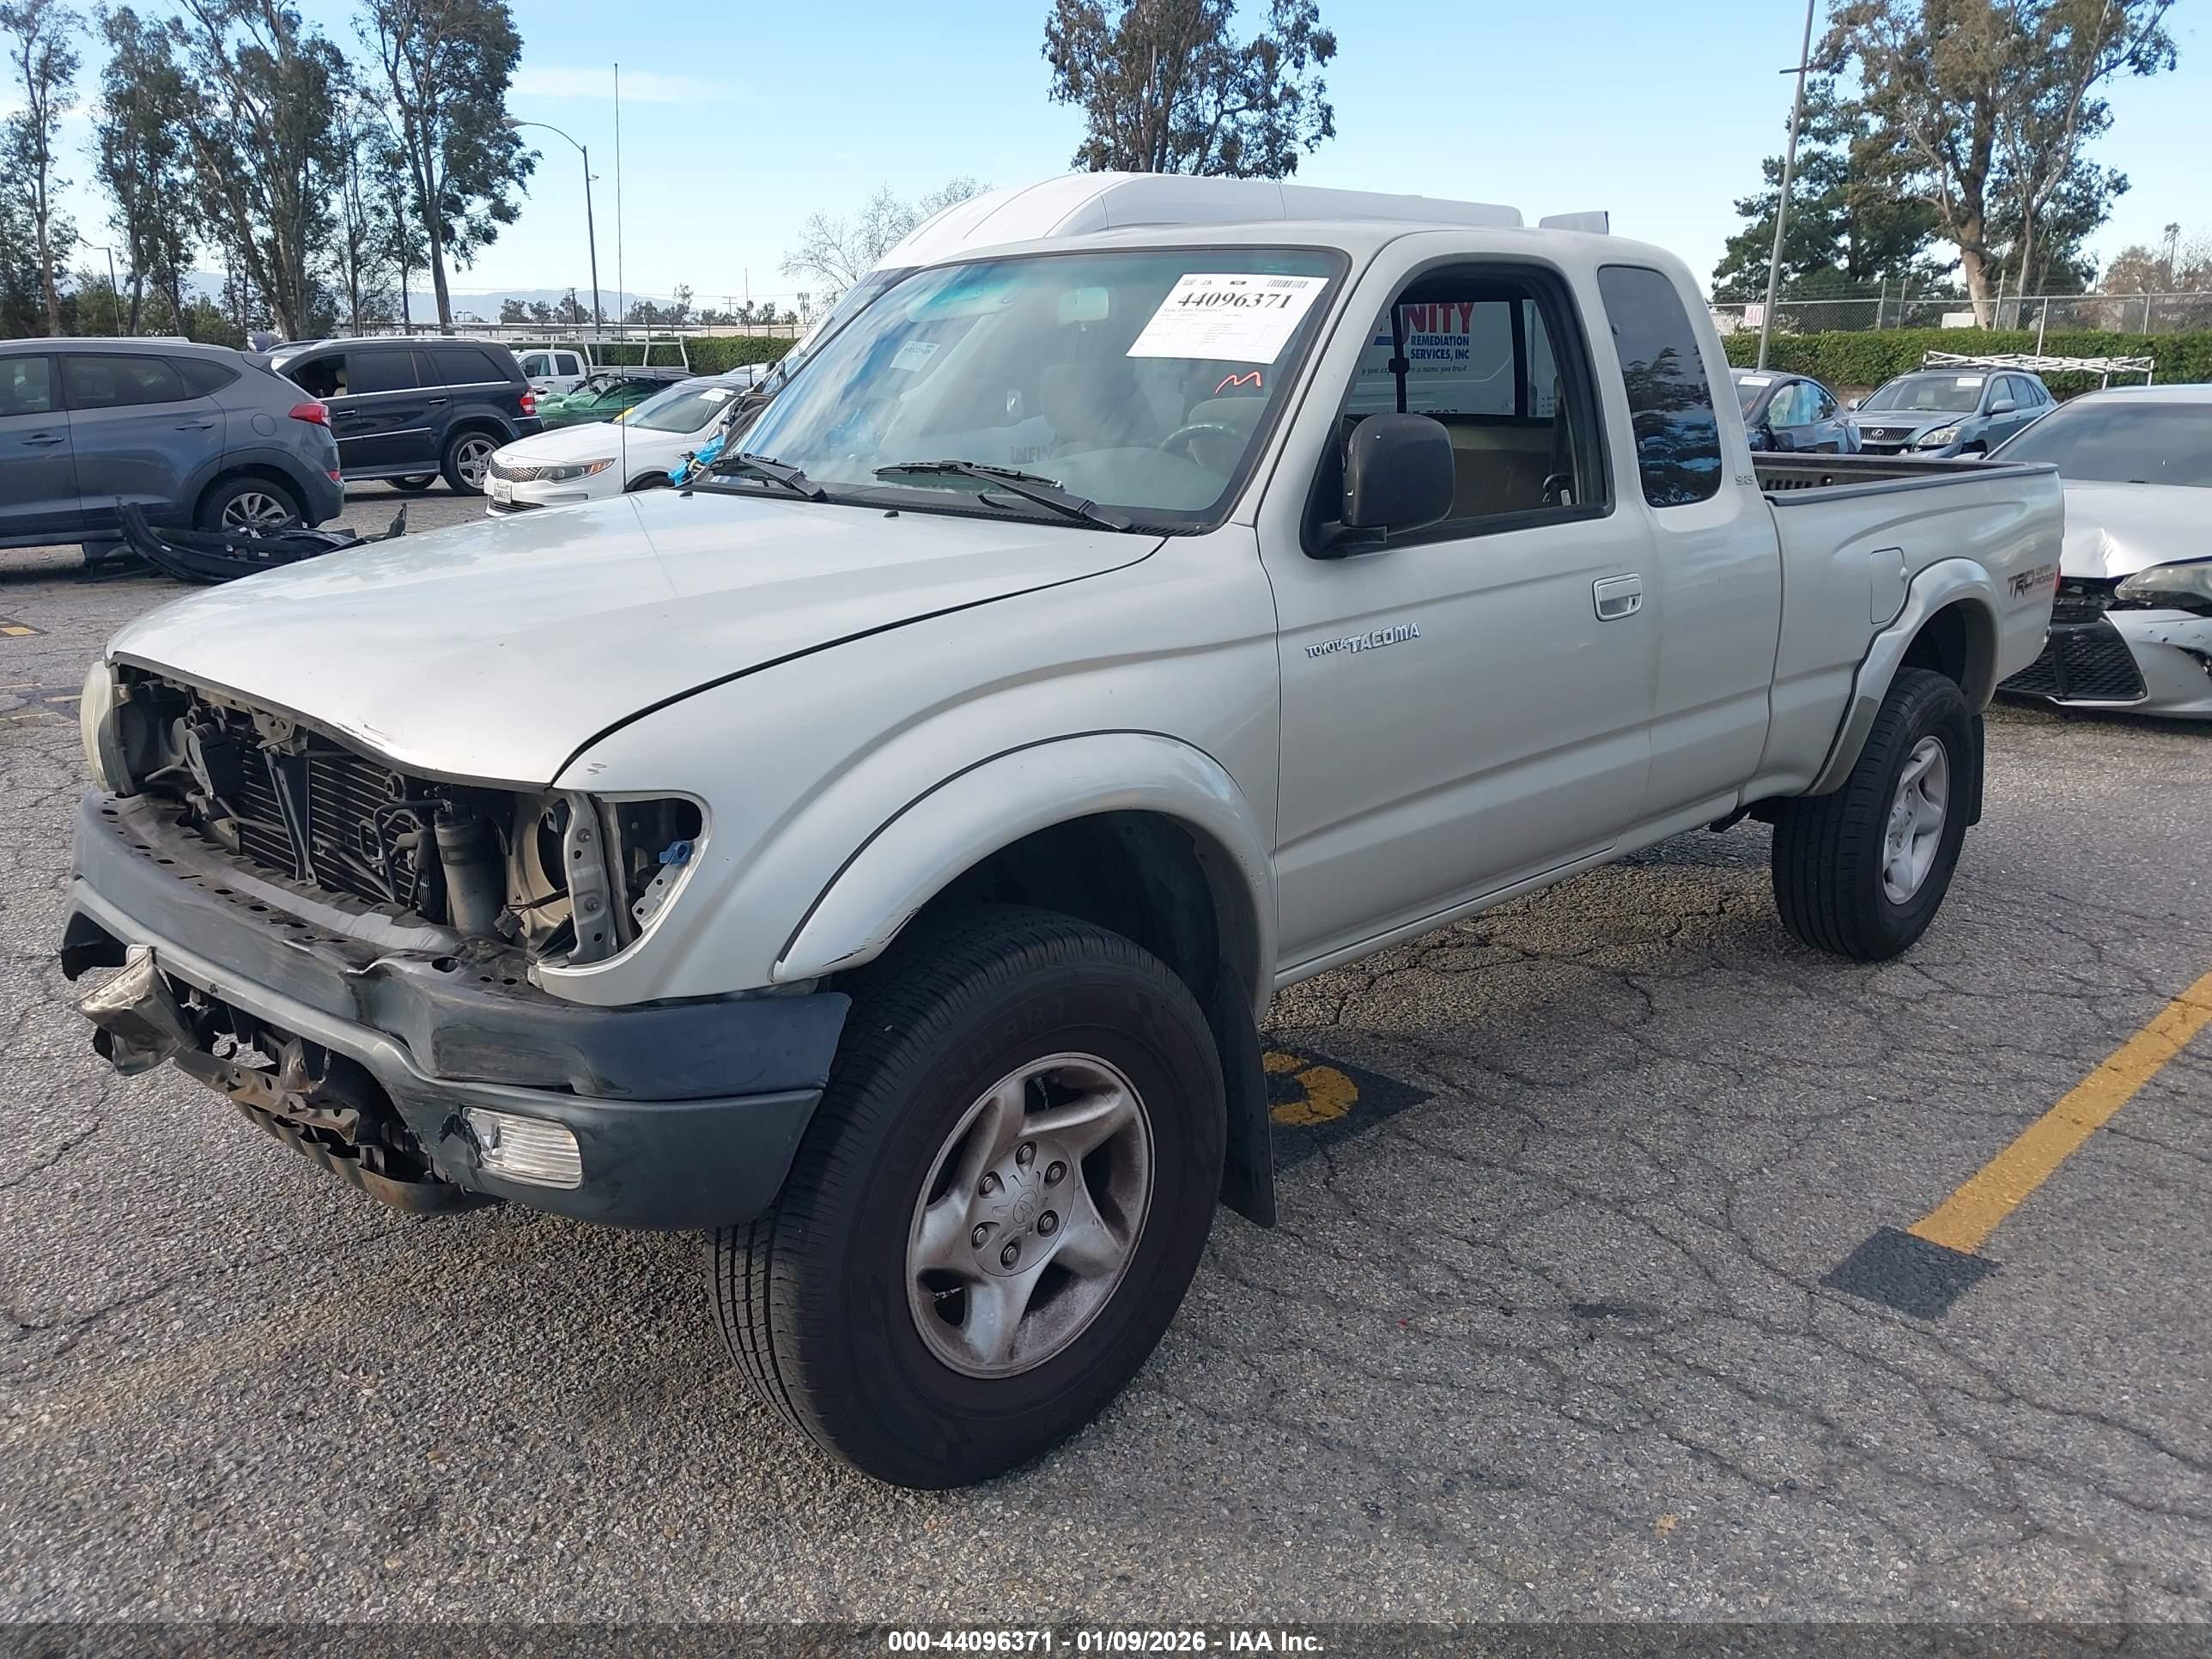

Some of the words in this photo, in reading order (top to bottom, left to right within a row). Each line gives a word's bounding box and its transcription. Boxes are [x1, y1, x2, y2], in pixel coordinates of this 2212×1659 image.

[1177, 292, 1293, 309] 44096371
[1411, 336, 1470, 347] REMEDIATION
[1411, 349, 1453, 362] SERVICES,
[1455, 349, 1470, 360] INC
[2007, 568, 2035, 599] TRD
[1304, 638, 1348, 659] TOYOTA
[1347, 622, 1421, 653] TACOMA
